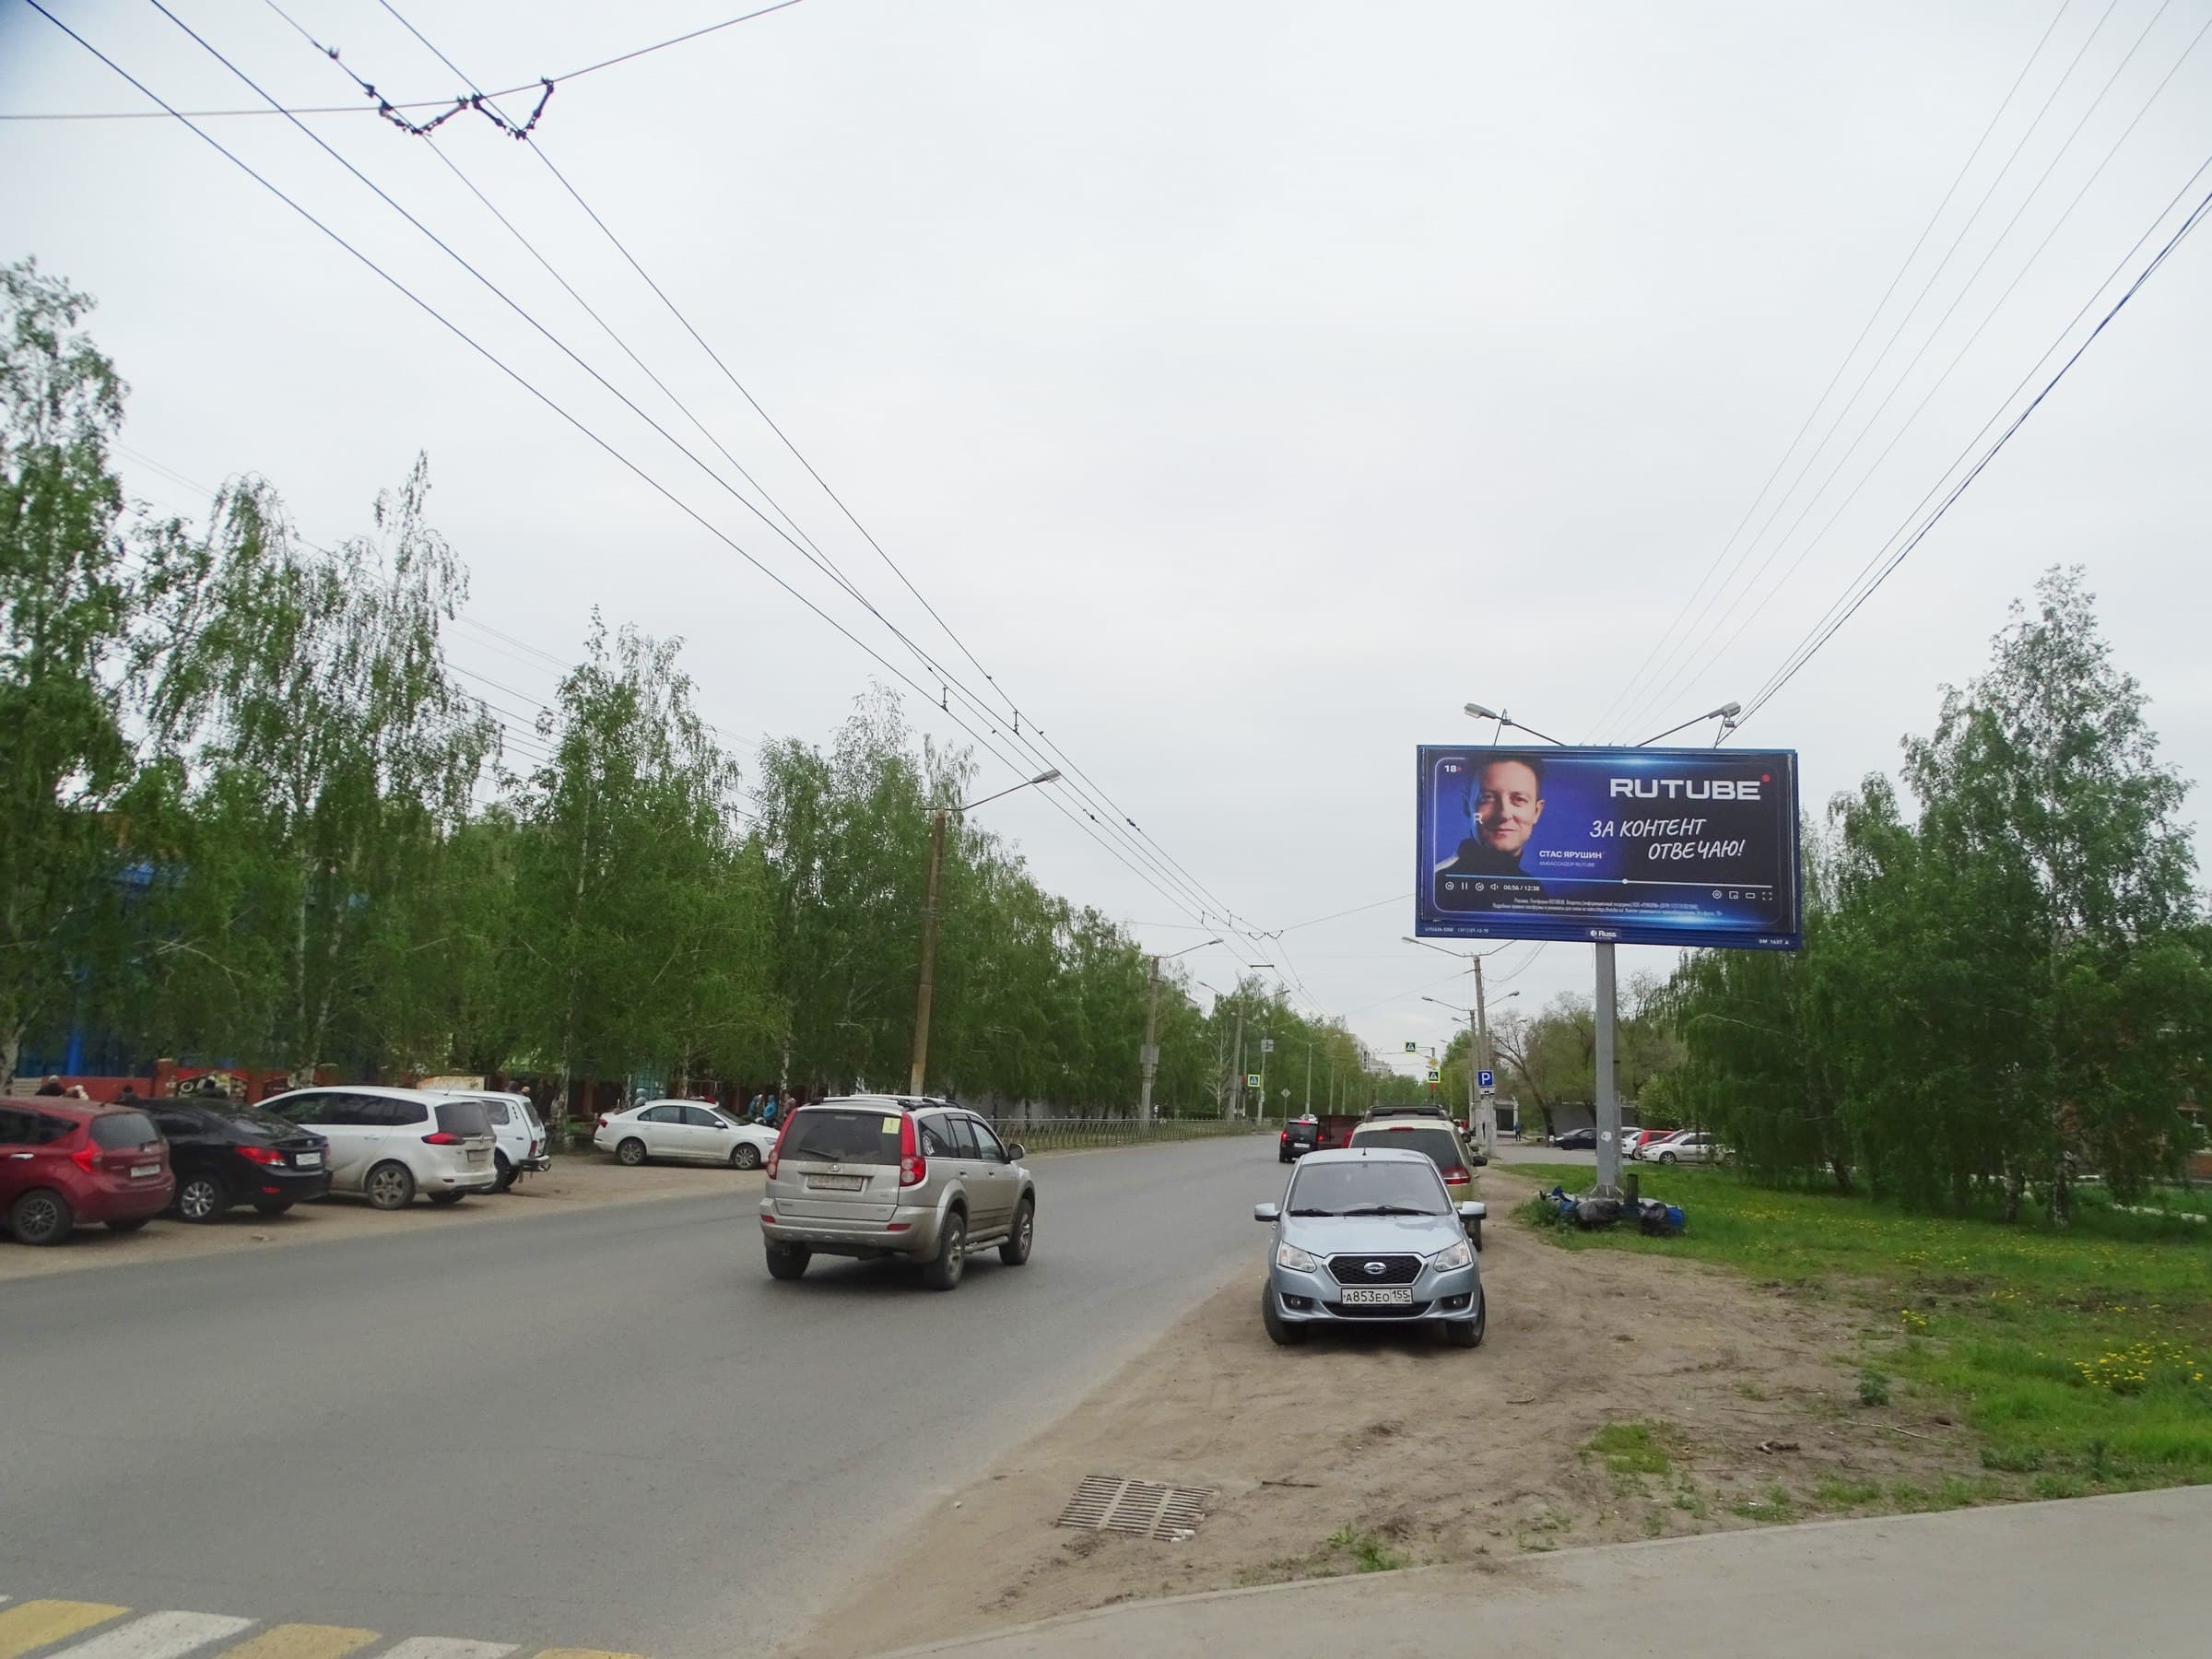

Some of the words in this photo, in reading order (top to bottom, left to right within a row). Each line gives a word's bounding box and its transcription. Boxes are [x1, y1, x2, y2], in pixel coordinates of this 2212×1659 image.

[1444, 765, 1462, 773] 18+
[1610, 778, 1761, 800] RUTUBE
[1589, 819, 1614, 838] ЗА
[1619, 818, 1706, 838] КОНТЕНТ
[1539, 850, 1562, 858] СТАС
[1563, 851, 1602, 859] ЯРУШИН
[1648, 839, 1746, 860] ОТВЕЧАЮ!
